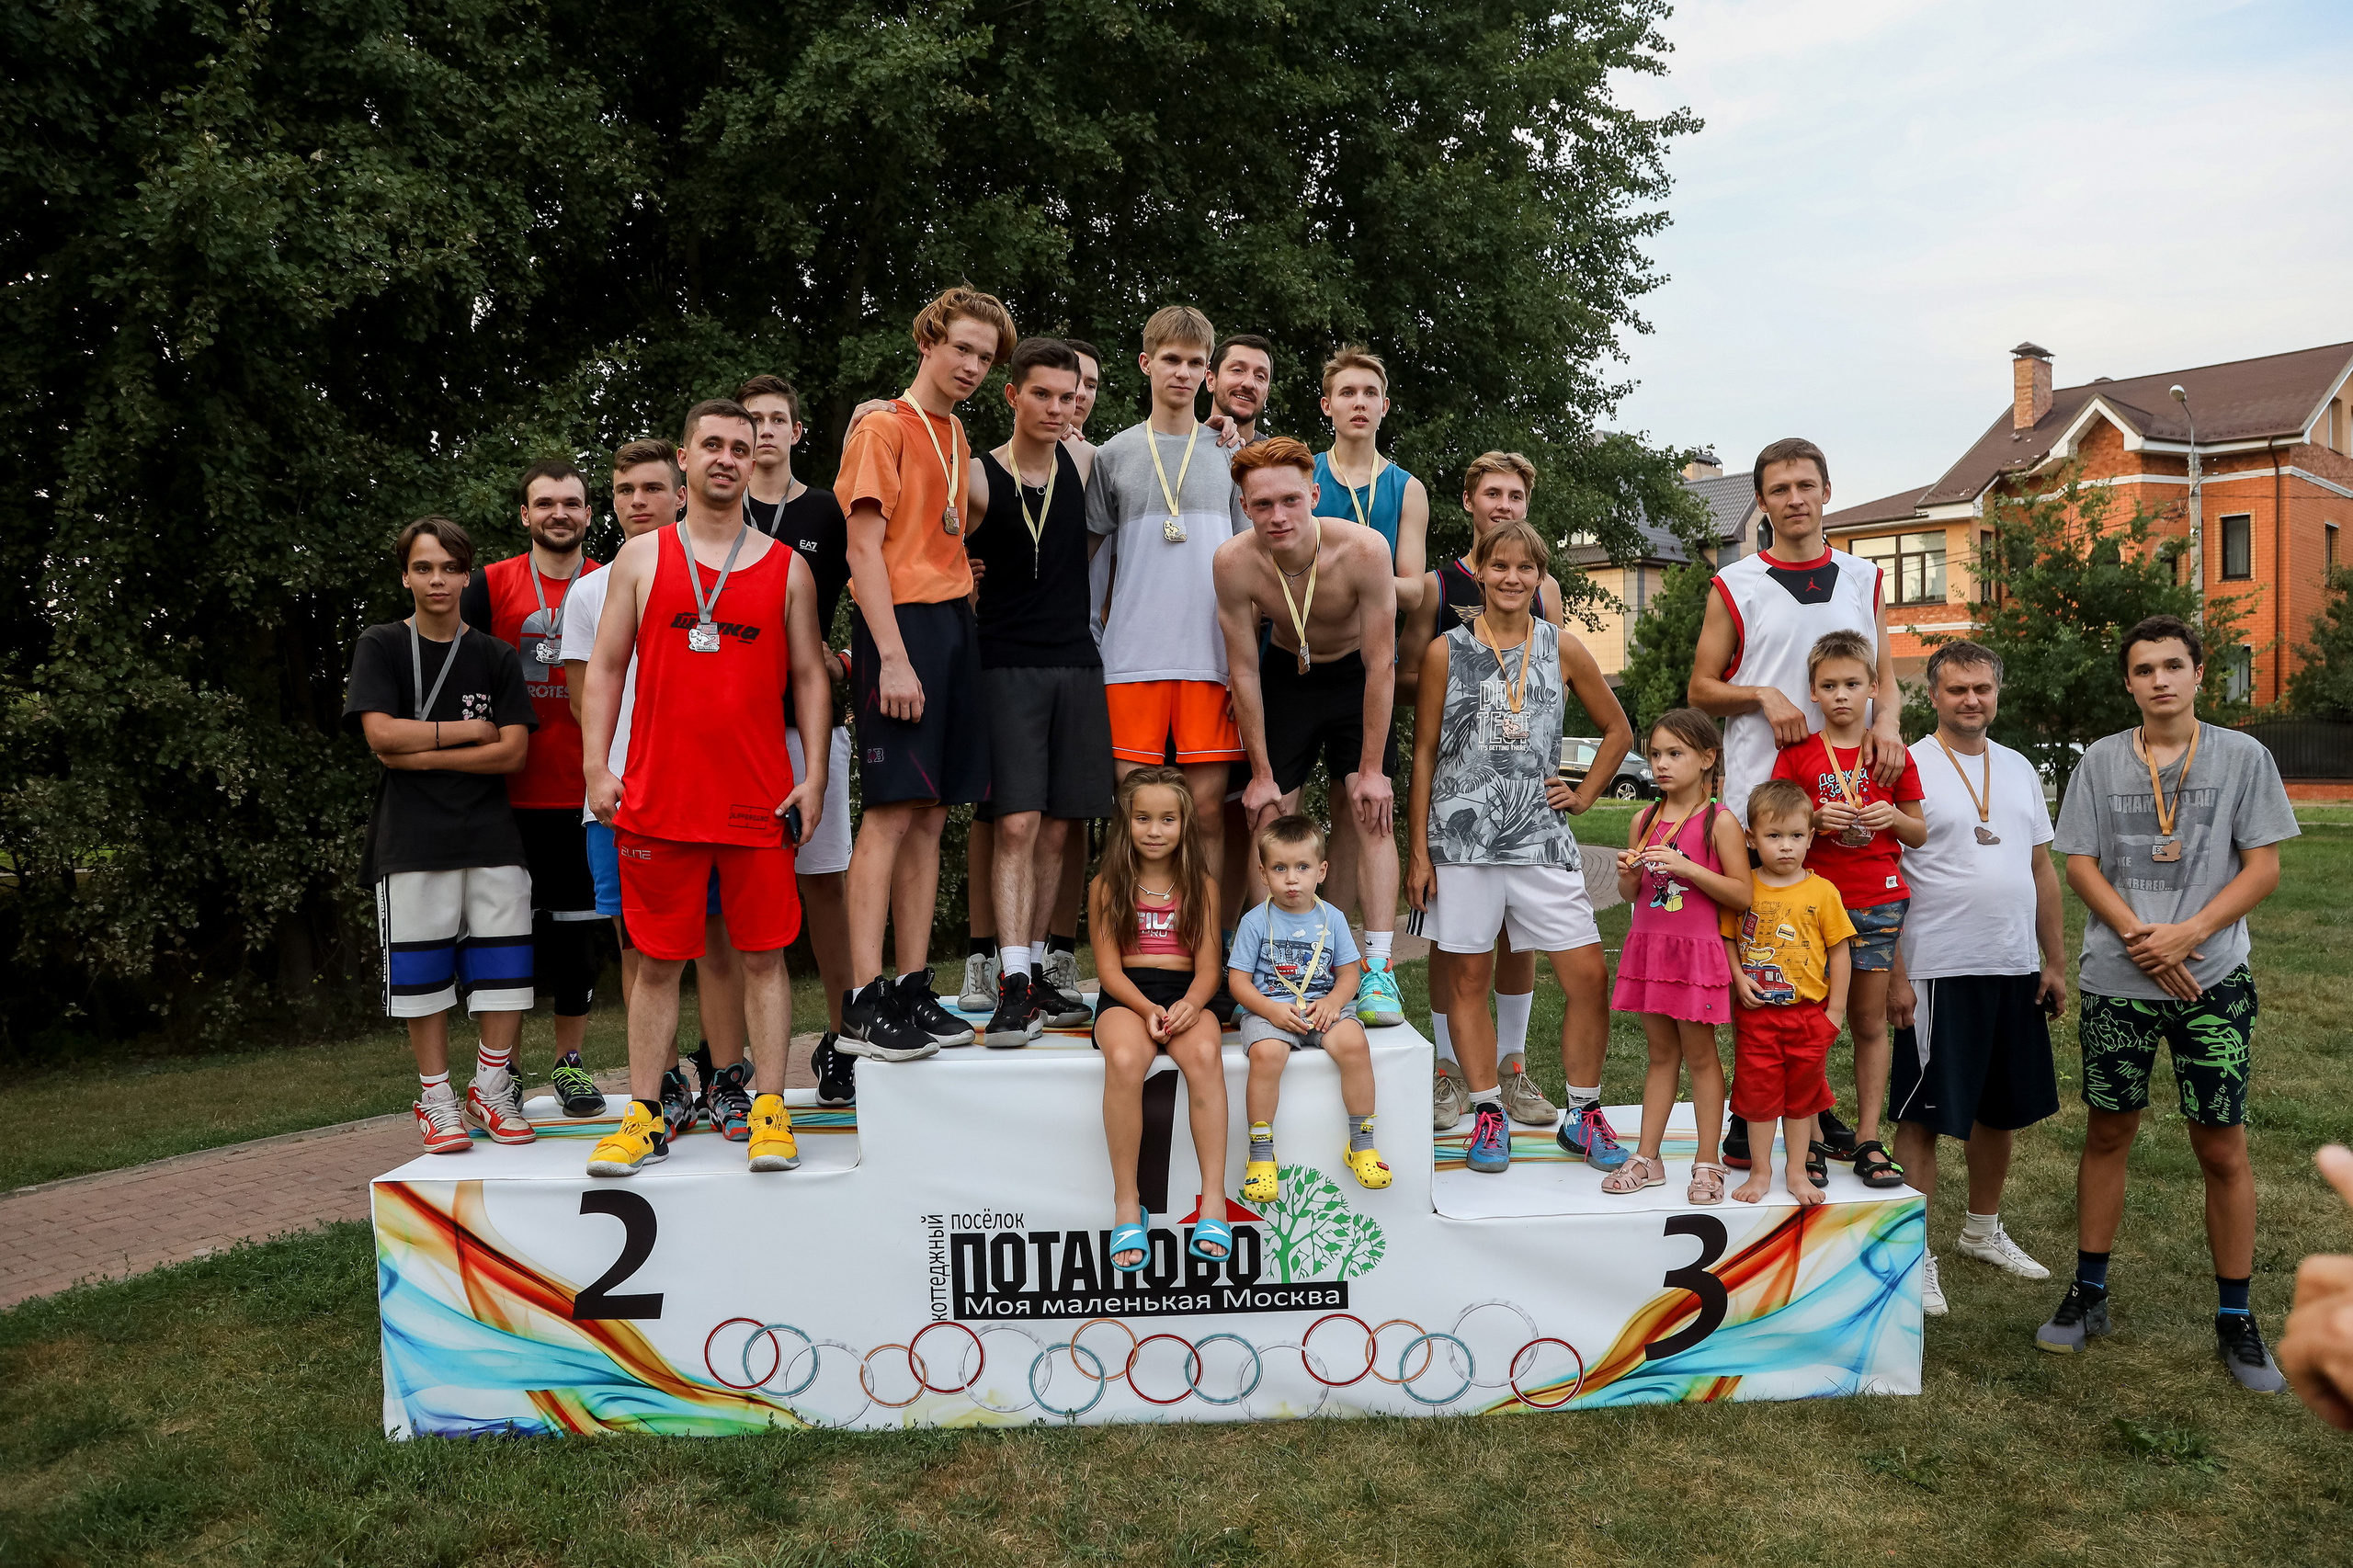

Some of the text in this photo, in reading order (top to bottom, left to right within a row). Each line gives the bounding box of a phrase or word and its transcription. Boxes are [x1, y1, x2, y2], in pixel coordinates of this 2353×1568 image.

[800, 540, 818, 550] EA7
[620, 845, 652, 860] ELITE
[950, 1208, 1025, 1230] посёлок
[572, 1188, 665, 1320] 2
[920, 1214, 950, 1321] коттеджный
[1644, 1213, 1728, 1361] 3
[964, 1289, 1341, 1315] Моя маленькая Москва
